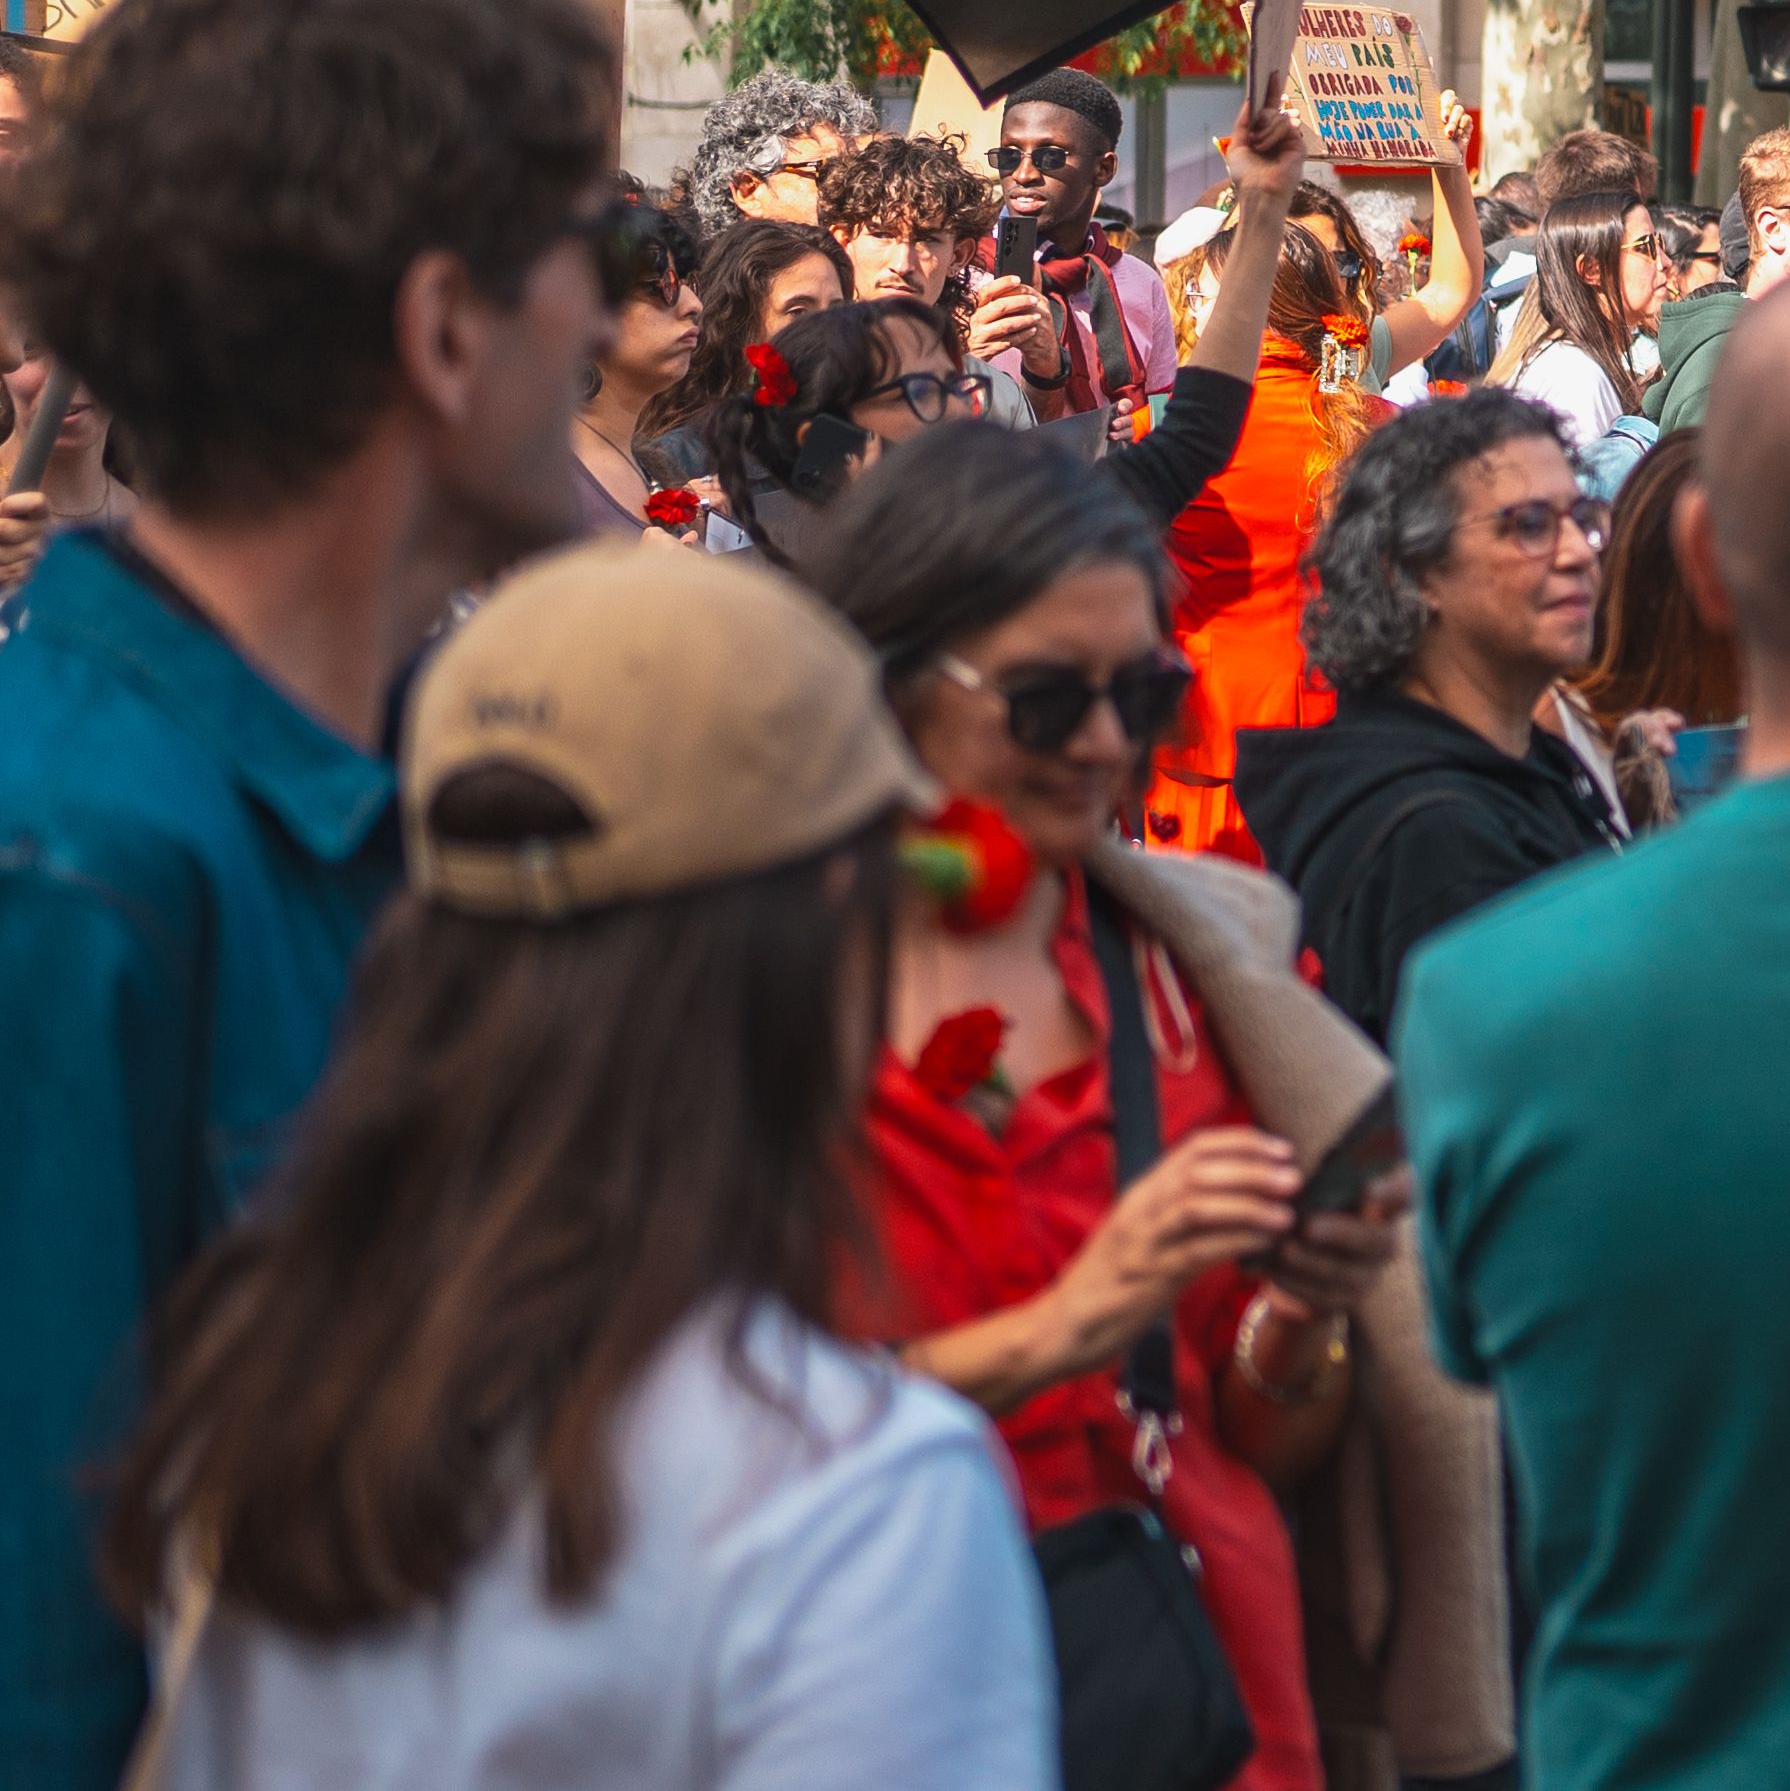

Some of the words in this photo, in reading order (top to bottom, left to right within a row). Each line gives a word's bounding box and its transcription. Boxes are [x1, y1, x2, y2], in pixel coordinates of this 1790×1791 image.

[1297, 8, 1367, 39] ULHERES
[1370, 13, 1393, 37] DO
[1305, 41, 1349, 70] MEU
[1351, 37, 1395, 68] PAÍS
[1308, 73, 1384, 96] OBRIGADA
[1388, 73, 1415, 97] POR
[1371, 140, 1437, 159] NAMORADA
